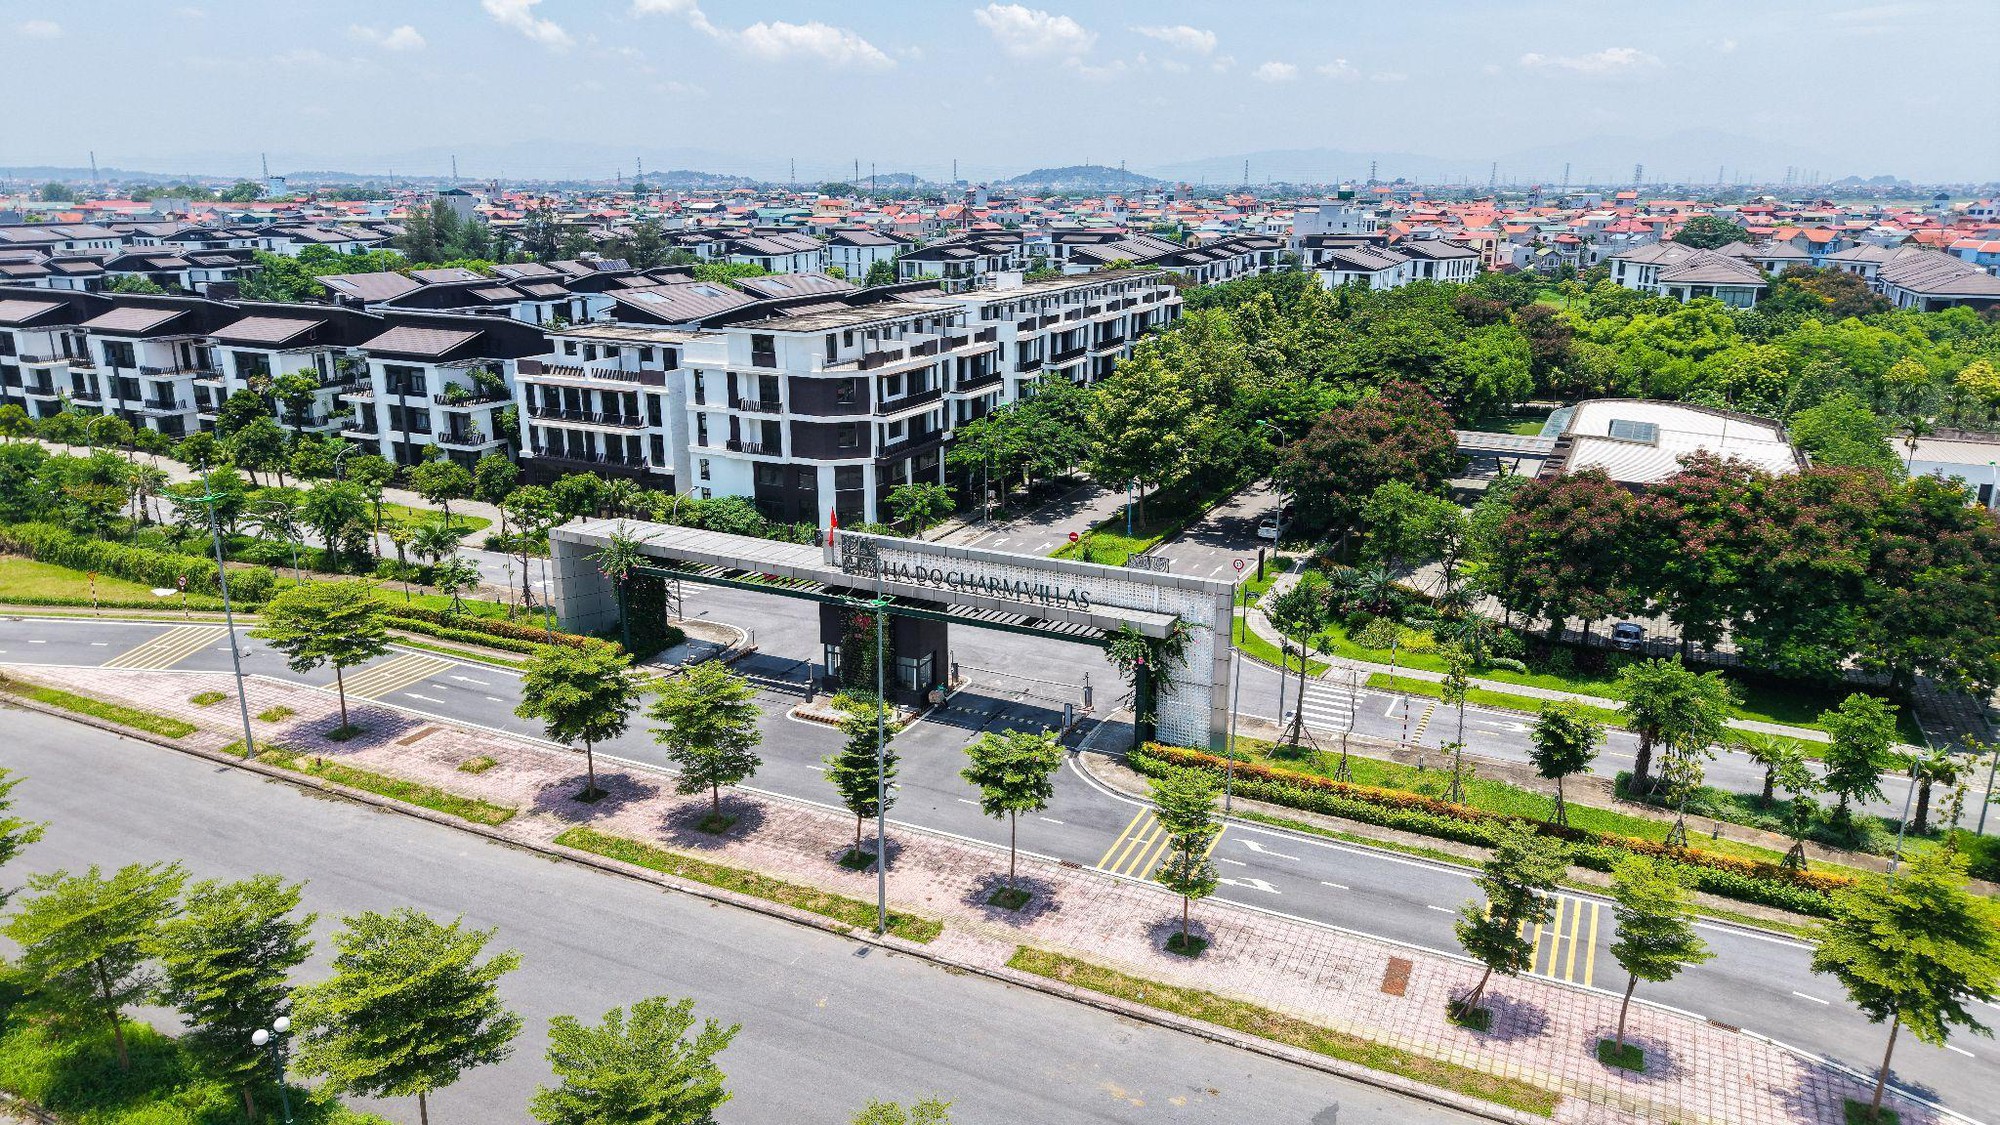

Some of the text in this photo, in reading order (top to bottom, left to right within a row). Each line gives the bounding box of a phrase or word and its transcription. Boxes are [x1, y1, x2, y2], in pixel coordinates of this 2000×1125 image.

[884, 561, 1090, 608] HA DO CHARM VILLAS
